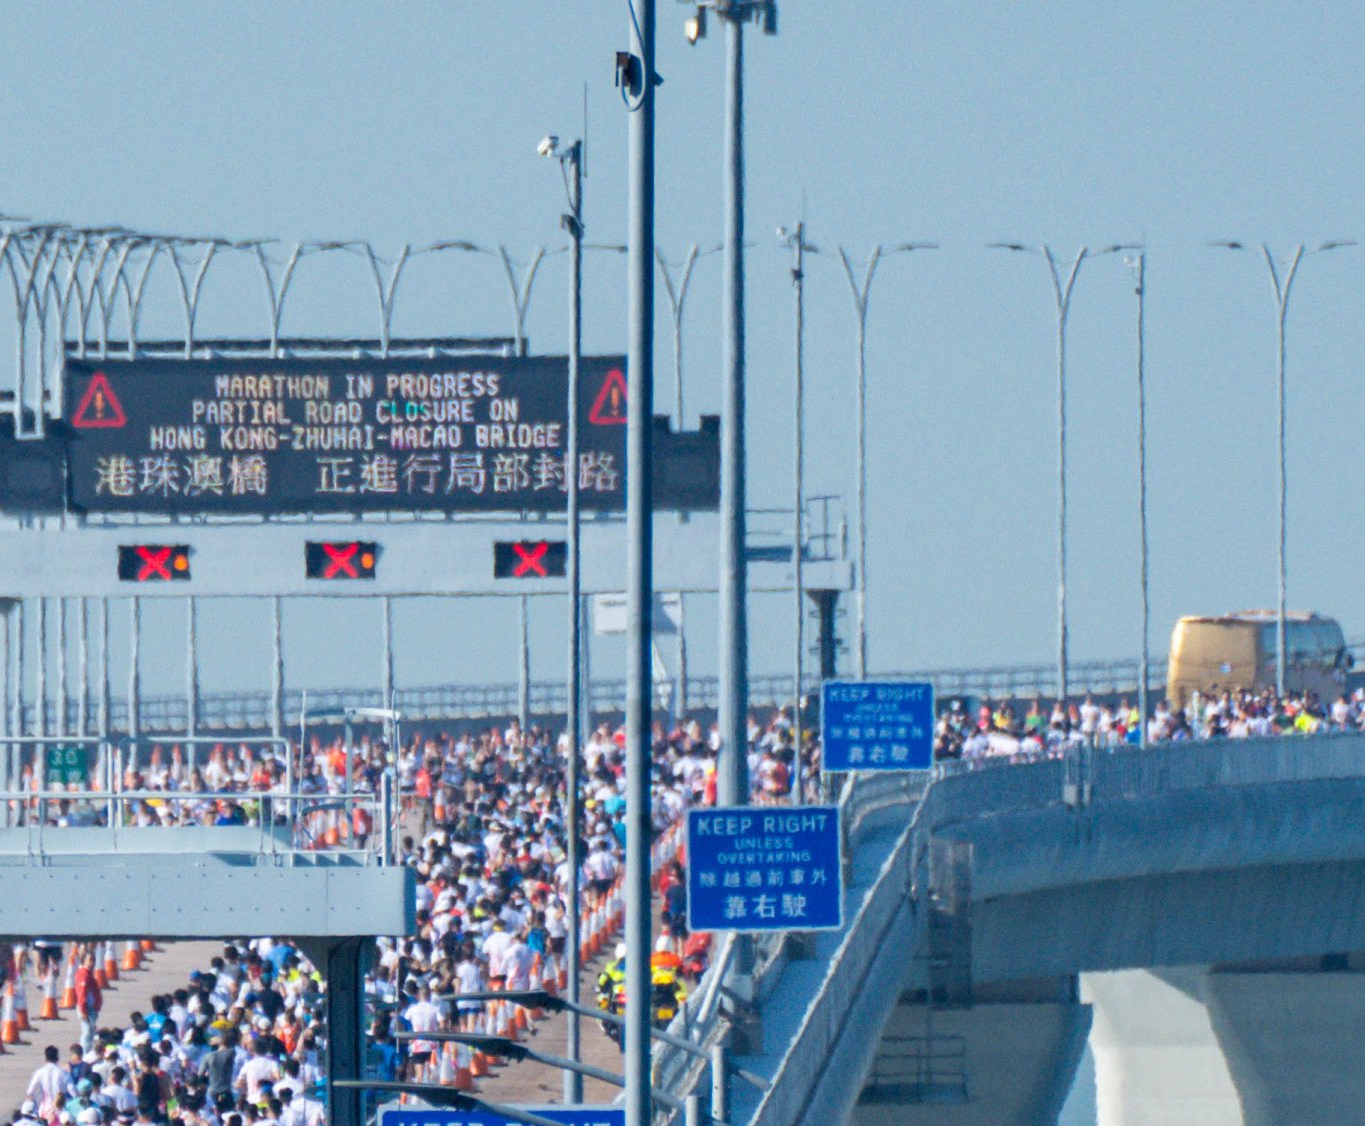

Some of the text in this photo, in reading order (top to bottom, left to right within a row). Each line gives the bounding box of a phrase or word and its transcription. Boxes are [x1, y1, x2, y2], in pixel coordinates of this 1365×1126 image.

[215, 373, 501, 399] MARATHON IN PROGRESS
[192, 399, 519, 424] PARTIAL ROAD CLOSURE ON
[150, 426, 206, 450] HONG
[475, 423, 561, 448] BRIDGE
[95, 452, 618, 497] 港珠澳橋 正進行局部封路
[698, 815, 827, 835] KEEP RIGHT
[734, 837, 793, 850] UNLESS
[717, 851, 811, 864] OVERTAKING
